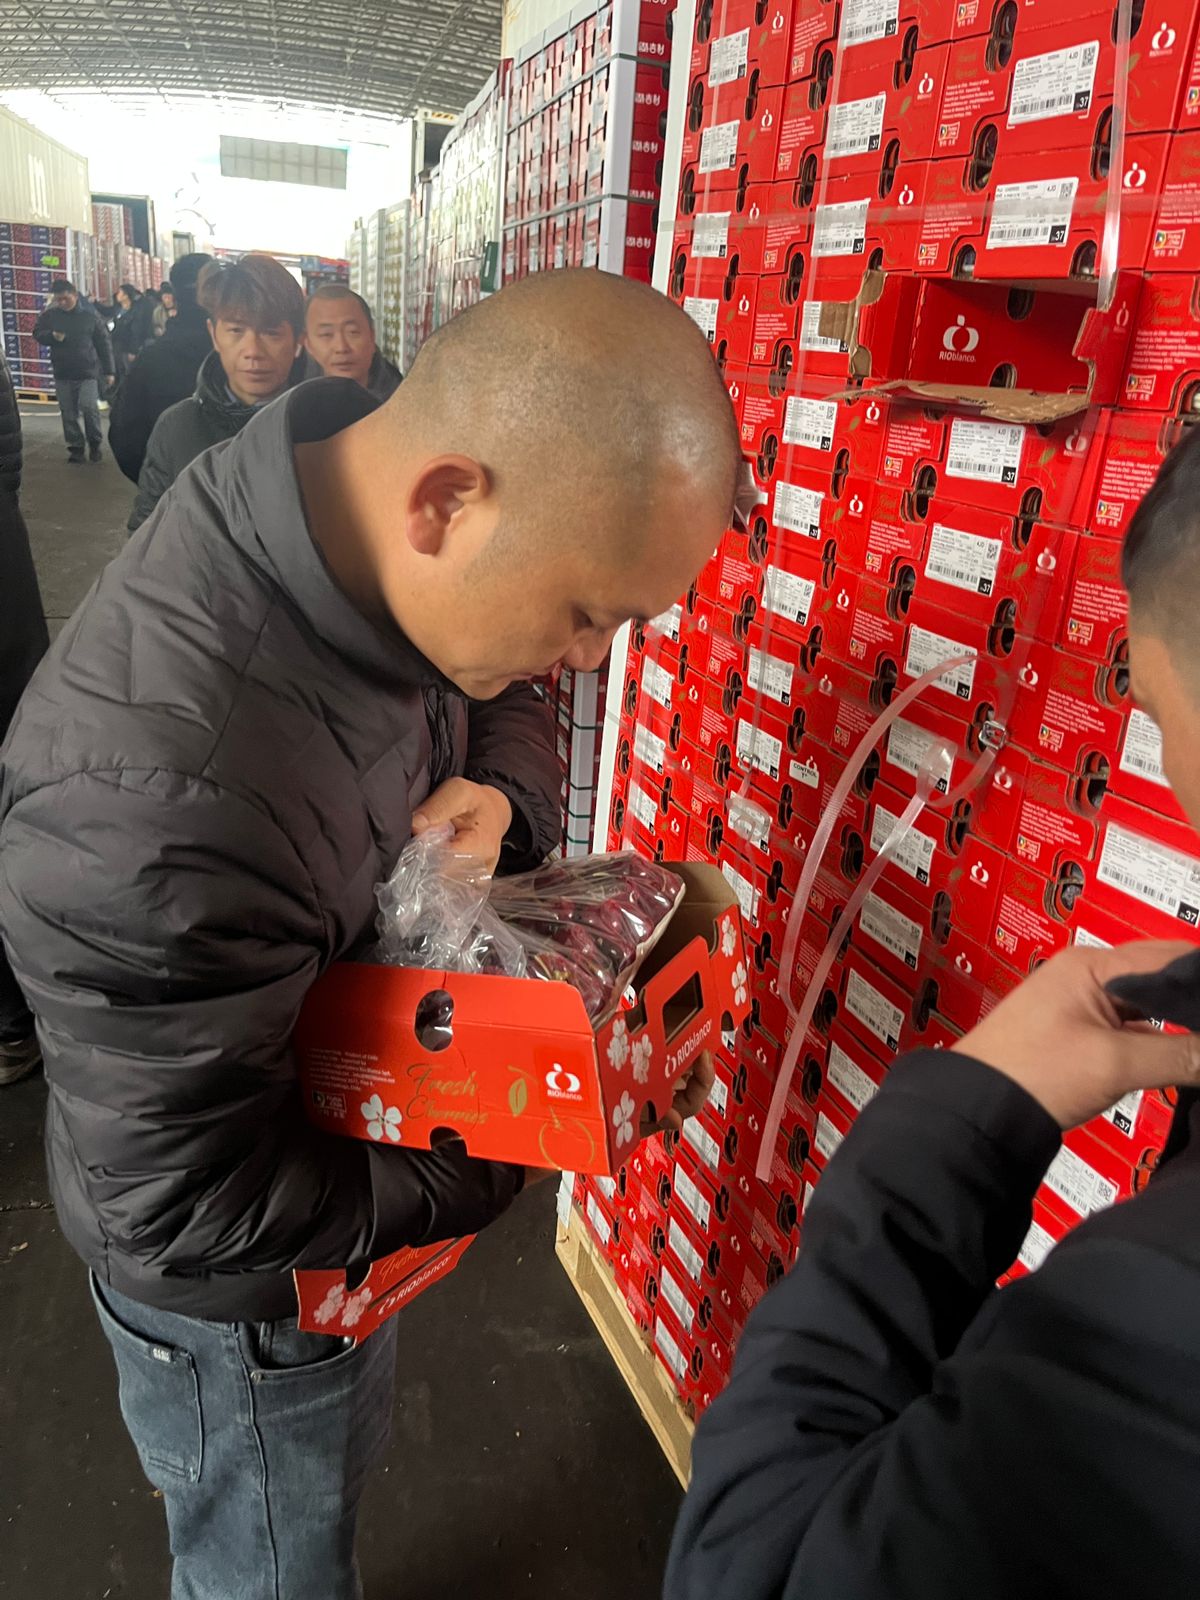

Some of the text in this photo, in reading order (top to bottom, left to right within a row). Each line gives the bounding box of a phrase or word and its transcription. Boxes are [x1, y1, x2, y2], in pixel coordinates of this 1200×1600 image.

[1079, 96, 1089, 108] 37
[1055, 230, 1065, 241] 37
[1006, 472, 1015, 481] 37
[982, 583, 991, 593] 37
[793, 763, 817, 778] CONTROL
[1184, 910, 1197, 922] 37
[406, 1063, 478, 1097] Fresh
[1119, 1118, 1130, 1131] 37
